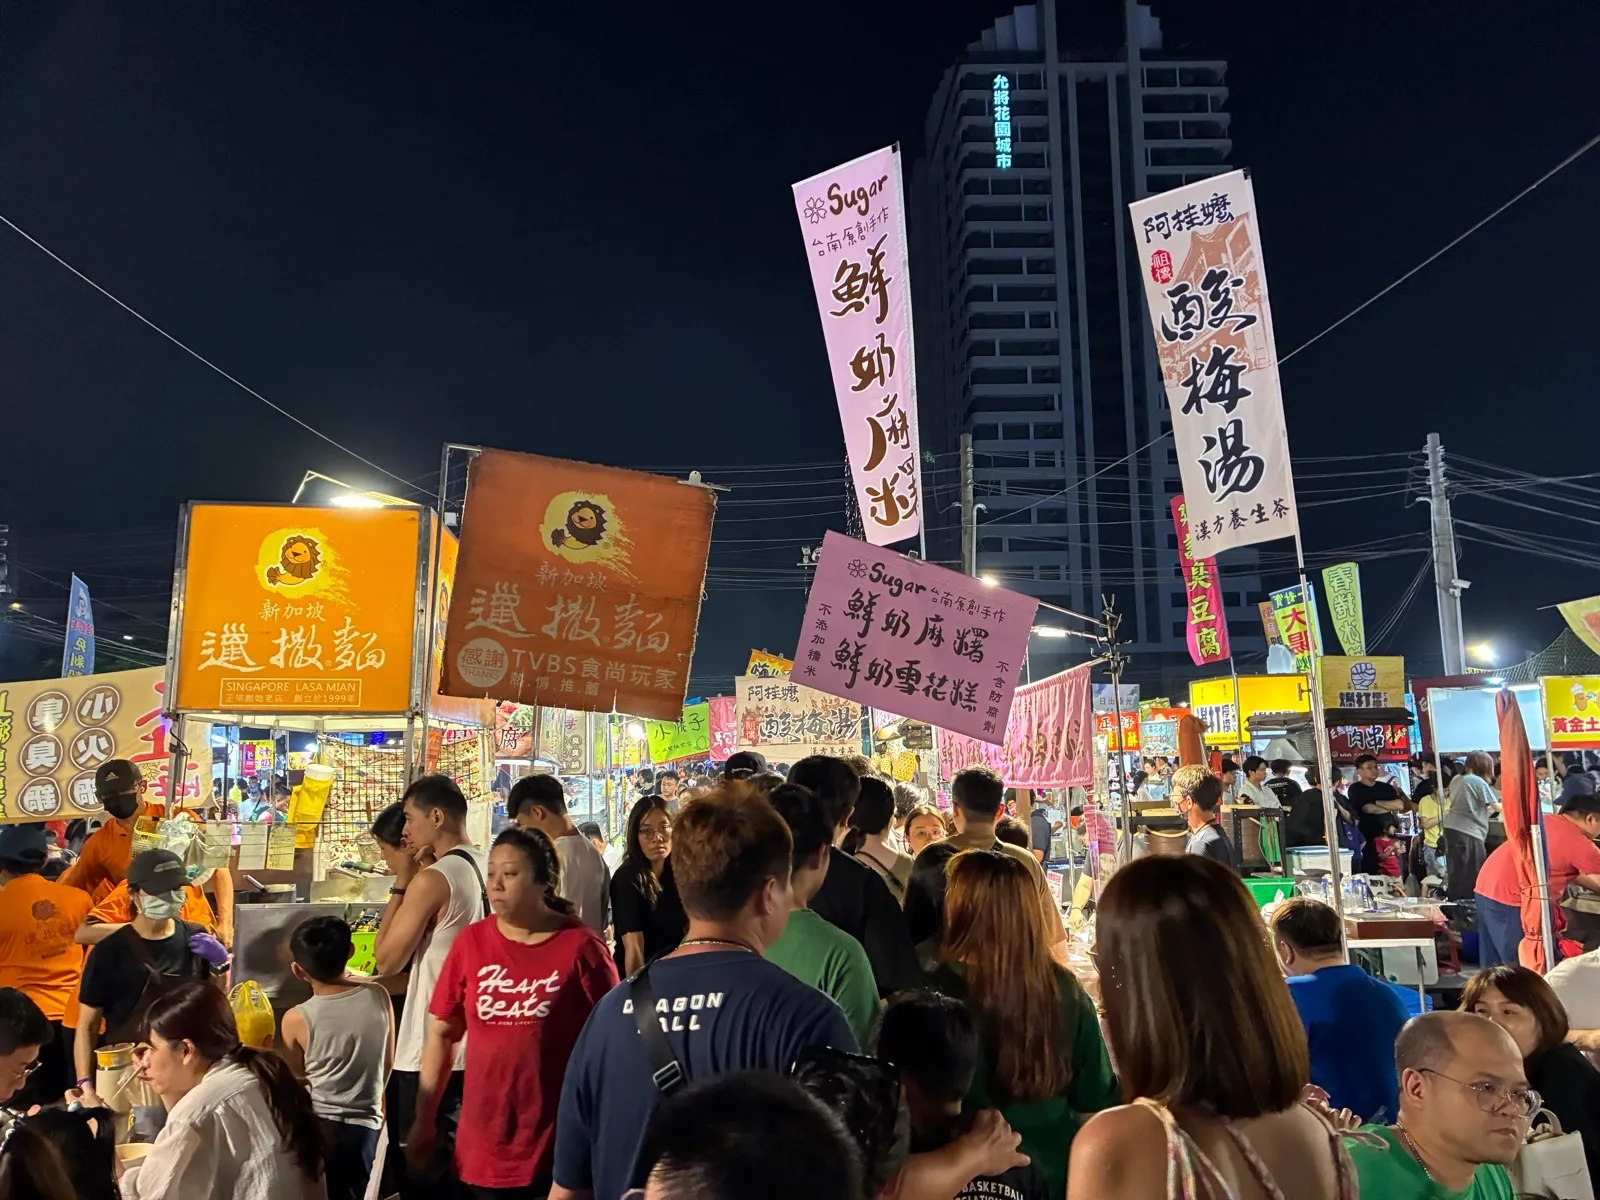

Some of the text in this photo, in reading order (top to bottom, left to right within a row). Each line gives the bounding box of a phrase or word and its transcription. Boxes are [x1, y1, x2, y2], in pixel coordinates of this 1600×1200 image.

[993, 74, 1012, 168] 允將花園城市
[827, 174, 888, 216] Sugar
[812, 206, 889, 257] 台南原創手作
[1143, 193, 1234, 243] 阿桂嬤
[1161, 268, 1265, 503] 酸梅湯
[1195, 498, 1290, 541] 漢方養生茶
[535, 561, 608, 593] 新加坡
[868, 561, 926, 597] Sugar
[258, 599, 326, 623] 新加坡
[931, 587, 1006, 624] 台南原創手作
[803, 602, 832, 677] 不添加糯米
[843, 587, 989, 664] 鮮奶麻糬
[461, 647, 504, 669] 感謝
[463, 667, 500, 680] THANKS
[830, 637, 980, 713] 鮮奶雪花糕
[226, 682, 356, 692] SINGAPORE LASA MIAN
[748, 683, 799, 703] 阿桂嬤
[983, 660, 1010, 734] 不含防腐劑
[760, 706, 860, 742] 酸梅湯
[477, 965, 561, 993] Heart
[476, 993, 551, 1020] Beats
[622, 992, 724, 1014] DAGON
